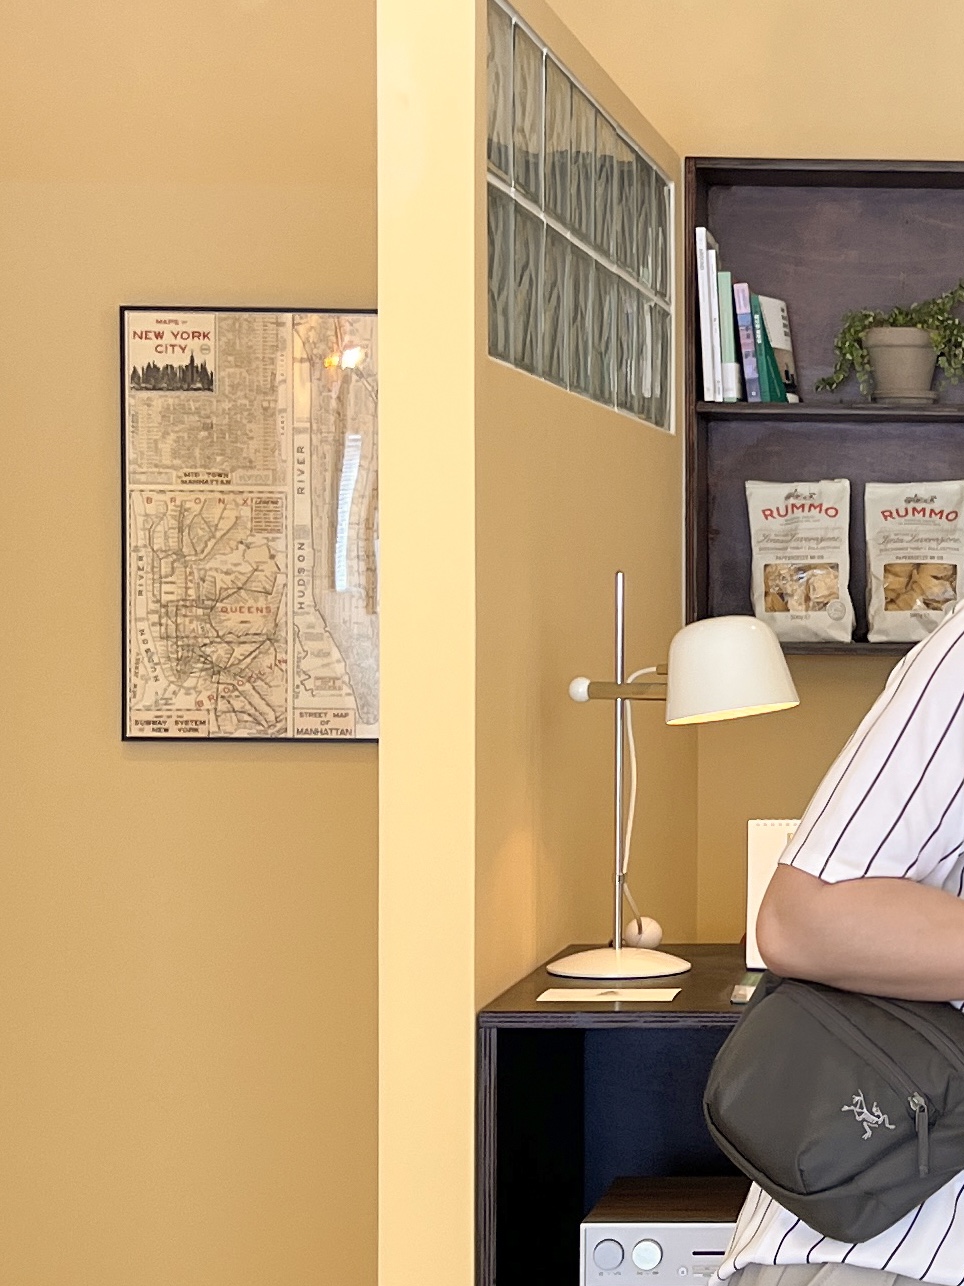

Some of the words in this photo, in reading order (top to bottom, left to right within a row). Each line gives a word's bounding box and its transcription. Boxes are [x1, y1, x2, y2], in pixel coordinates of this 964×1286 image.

[132, 330, 165, 341] NEW
[170, 330, 211, 341] YORK
[154, 344, 188, 354] CITY
[296, 445, 305, 495] RIVER
[761, 502, 839, 521] RUMMO
[880, 506, 959, 522] RUMMO
[297, 542, 305, 610] HUDSON
[220, 605, 272, 614] QUEENS
[299, 711, 328, 719] STREET
[296, 727, 353, 736] MANHATTAN
